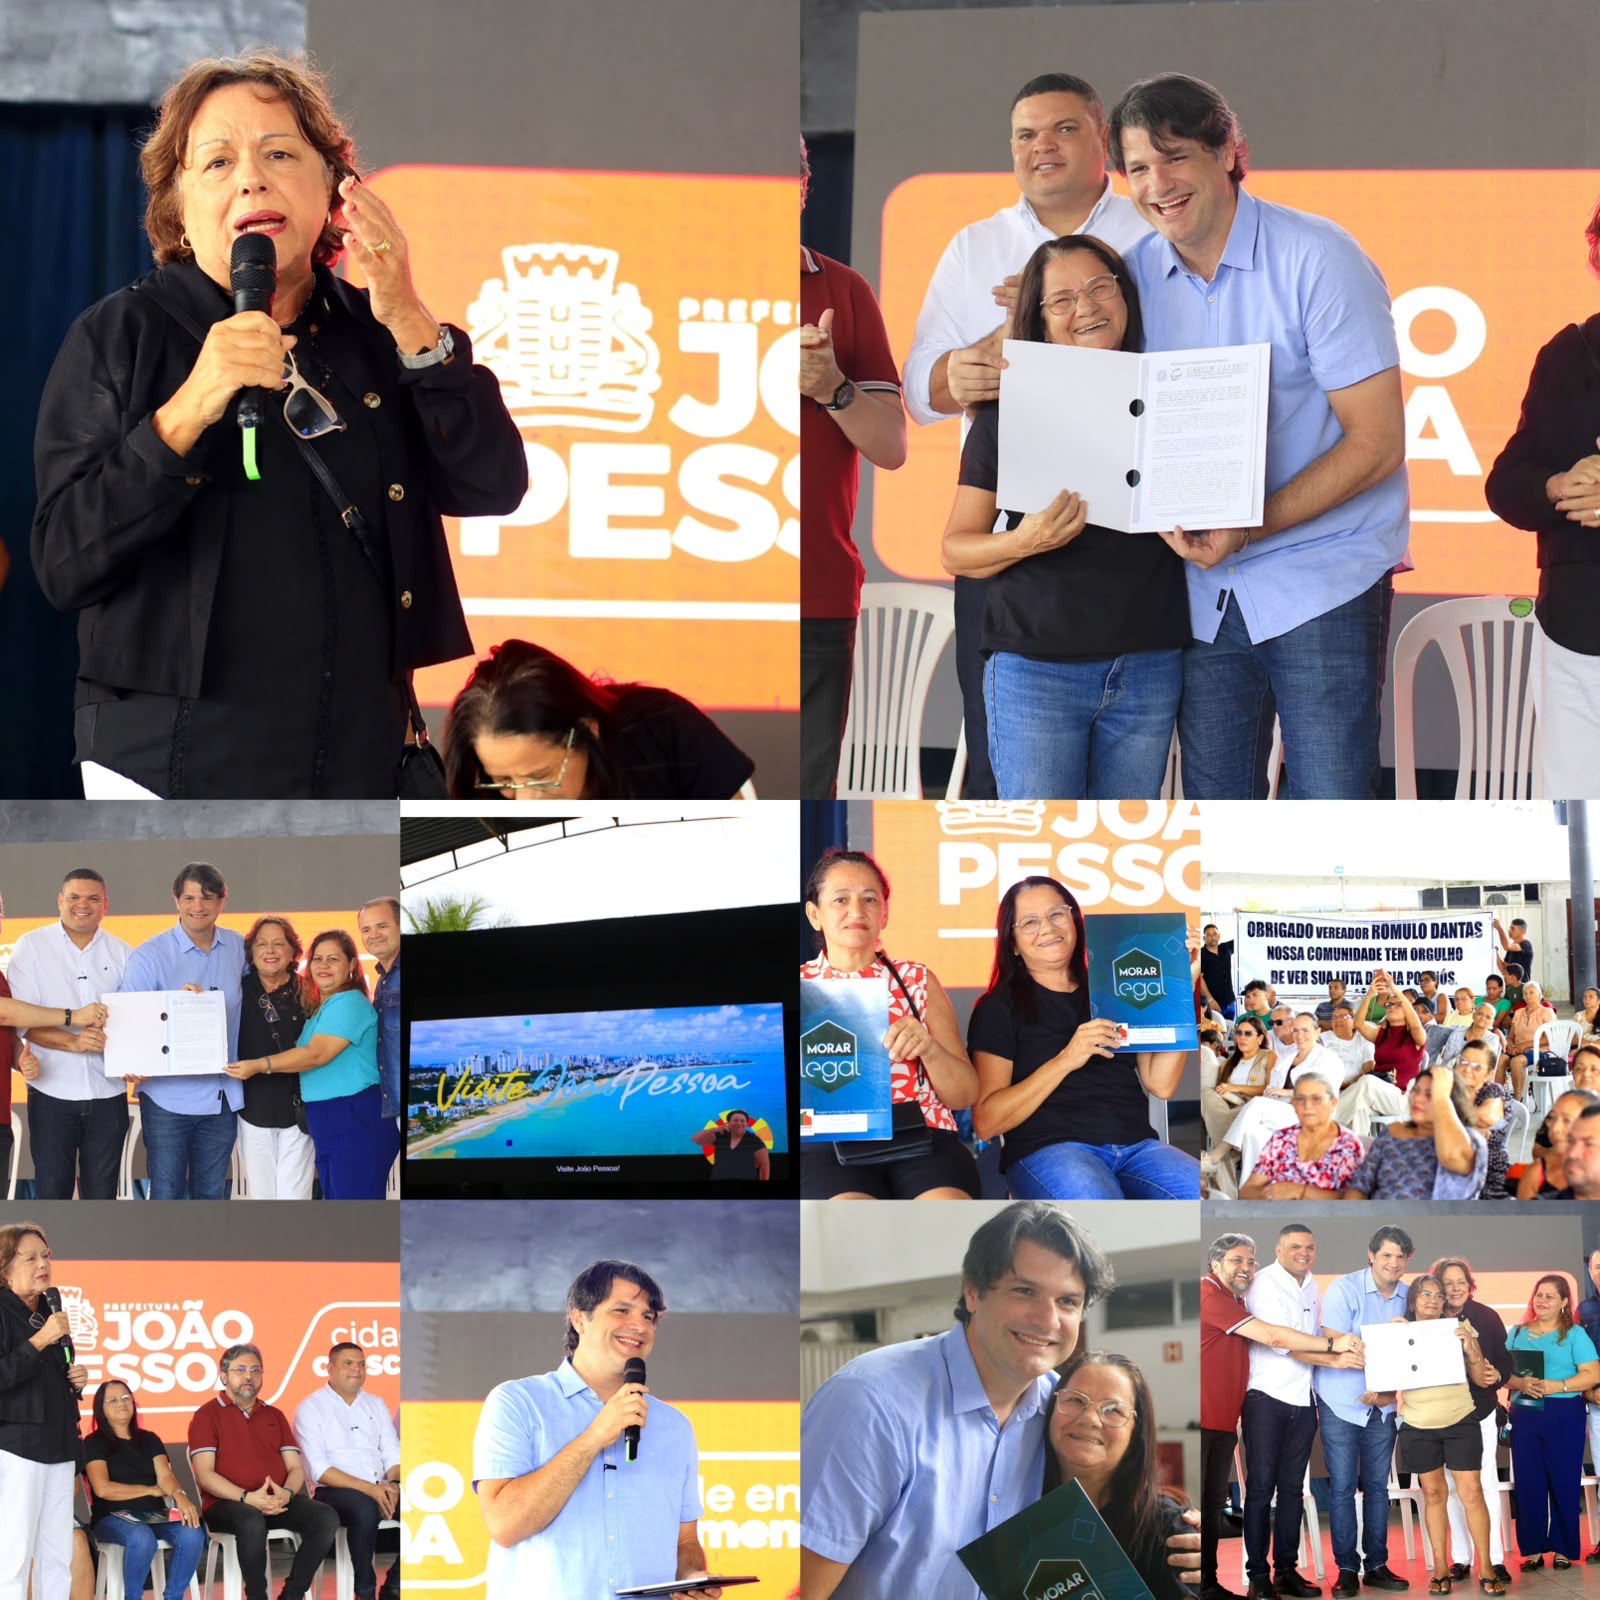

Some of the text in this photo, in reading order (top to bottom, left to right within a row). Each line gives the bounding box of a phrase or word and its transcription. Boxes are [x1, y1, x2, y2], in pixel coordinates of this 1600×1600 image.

[460, 441, 800, 562] PES
[1247, 921, 1483, 940] OBRIGADO VEREADOR ROMULO DANTAS
[1267, 946, 1463, 961] NOSSA COMUNIDADE TEM ORGULHO
[1119, 966, 1157, 976] MORAR
[1271, 970, 1285, 985] DE
[1287, 970, 1308, 985] VER
[1311, 970, 1333, 985] SUA
[807, 1042, 851, 1054] MORAR
[437, 1060, 751, 1111] Visite João Pessoa
[103, 1303, 180, 1311] PREFEITURA
[102, 1299, 254, 1351] JOÃO
[330, 1320, 400, 1348] cida
